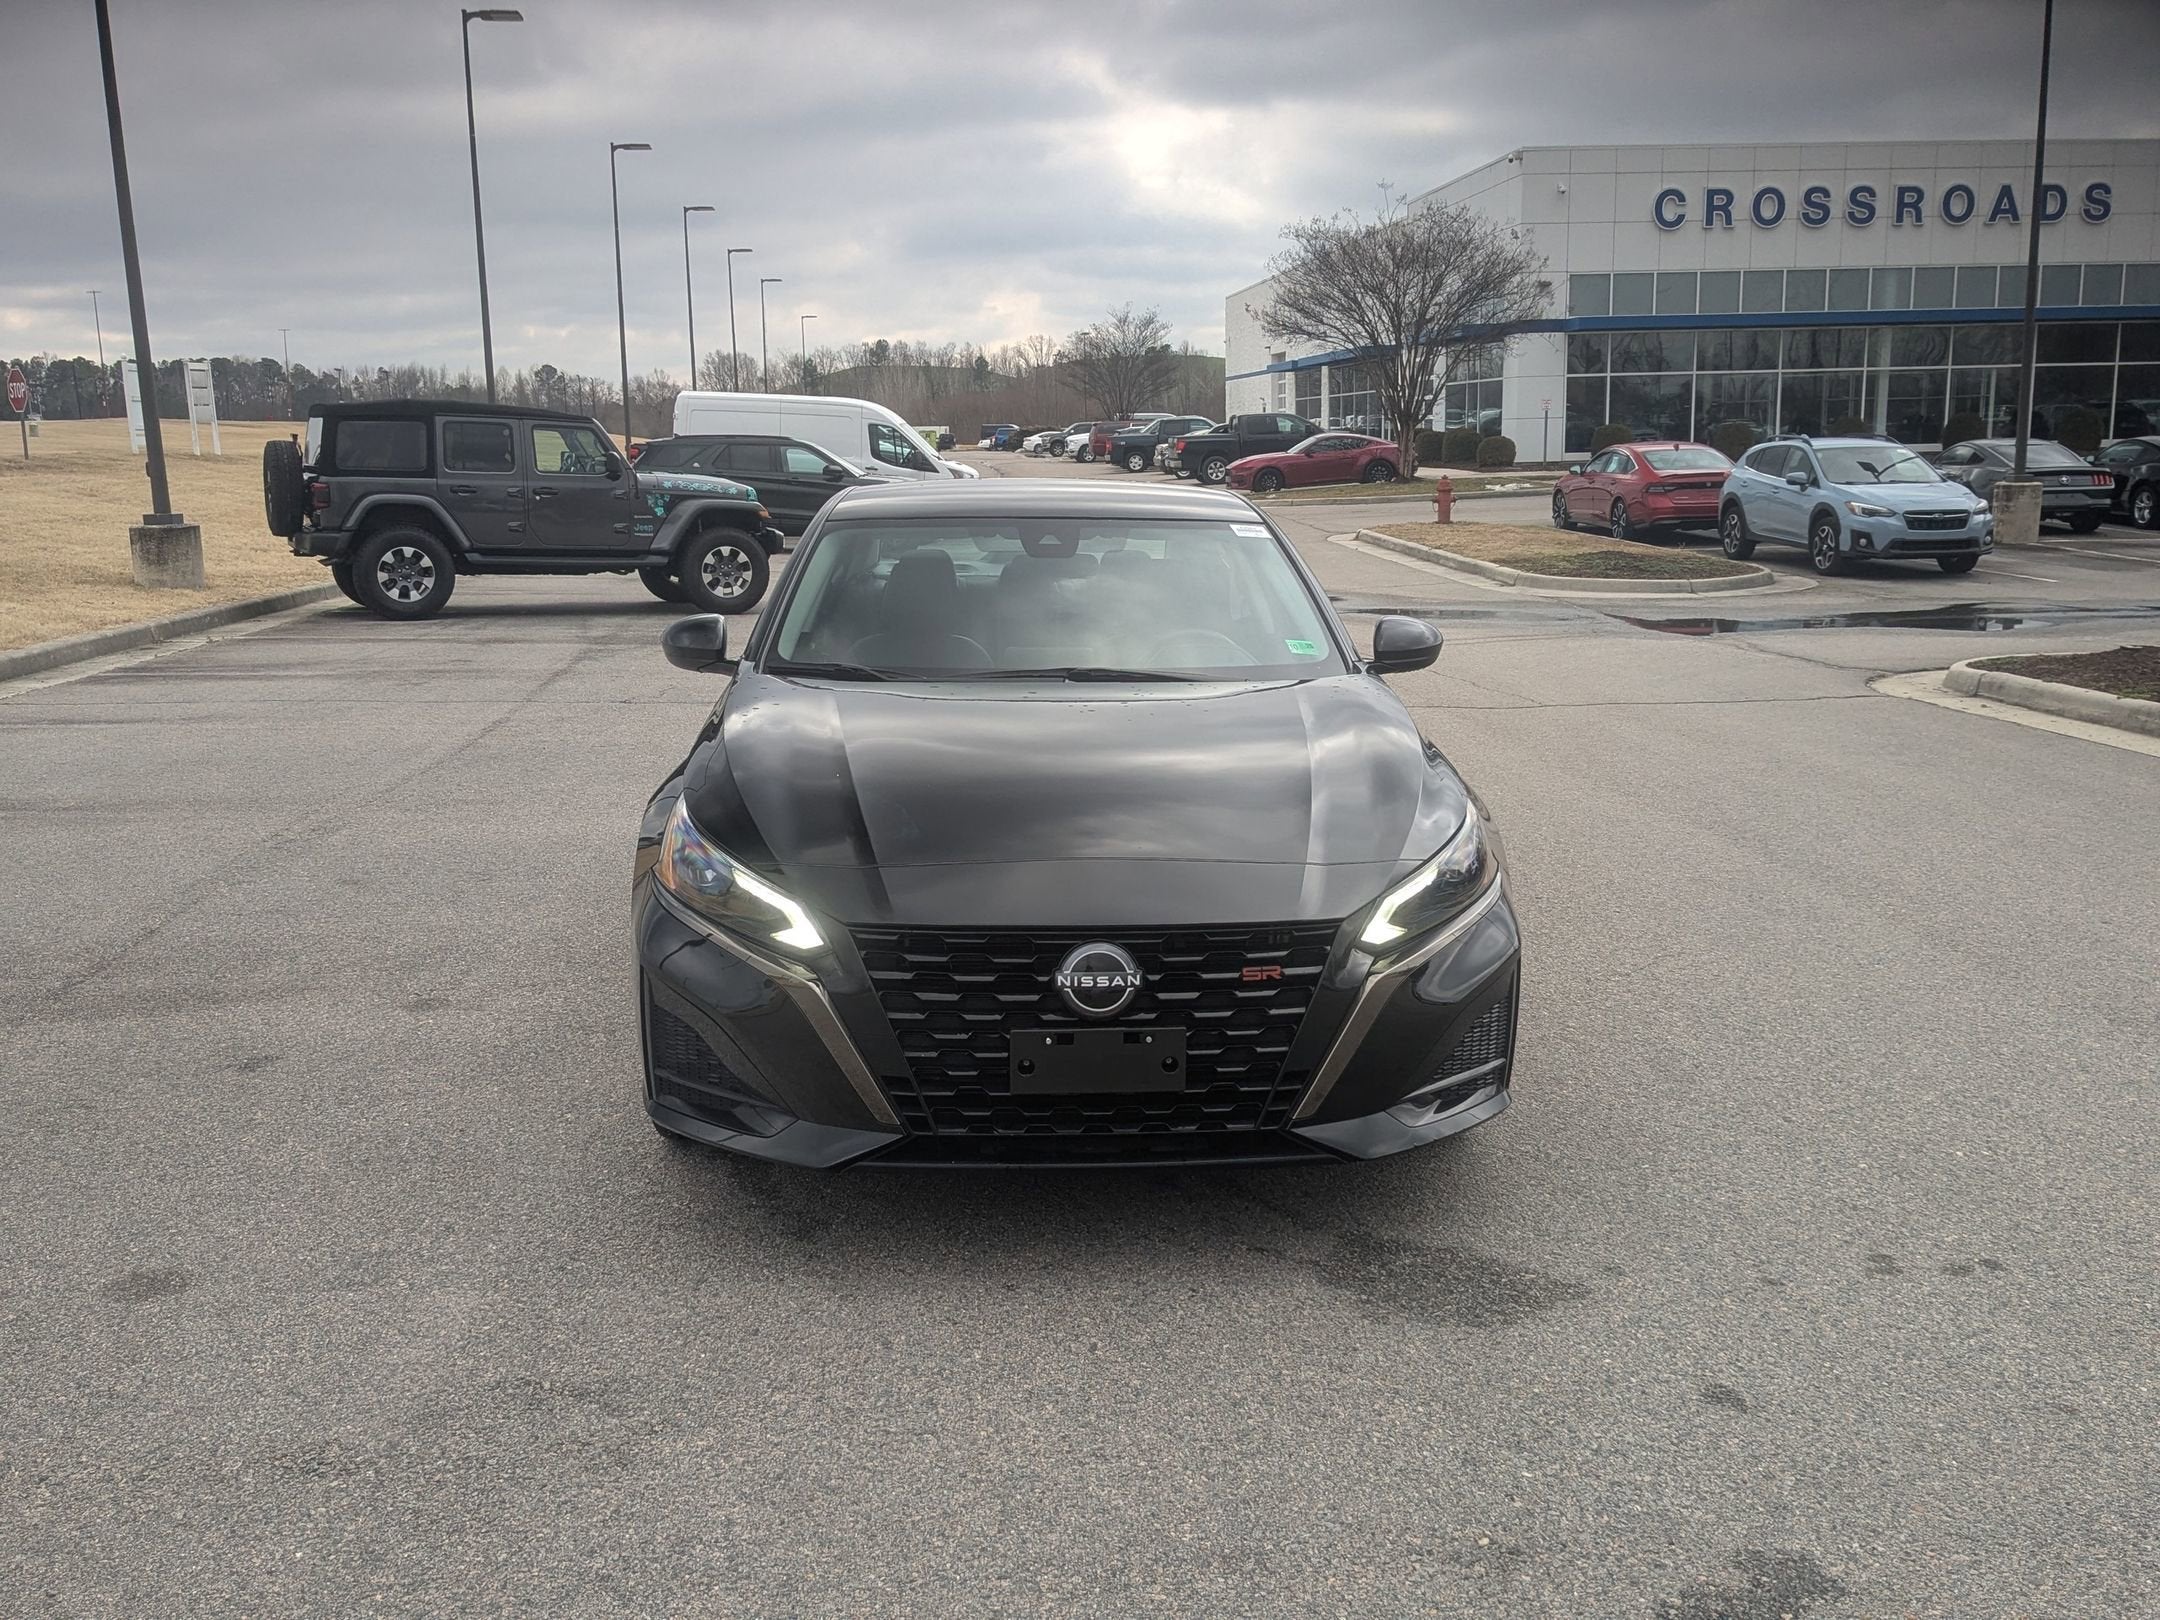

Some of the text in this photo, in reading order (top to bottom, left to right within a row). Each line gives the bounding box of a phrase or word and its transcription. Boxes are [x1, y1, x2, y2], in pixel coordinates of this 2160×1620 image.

[1653, 182, 2113, 230] CROSSROADS
[9, 382, 25, 399] STOP
[633, 523, 654, 533] Jeep
[1057, 974, 1140, 987] NISSAN
[1242, 965, 1282, 981] SR
